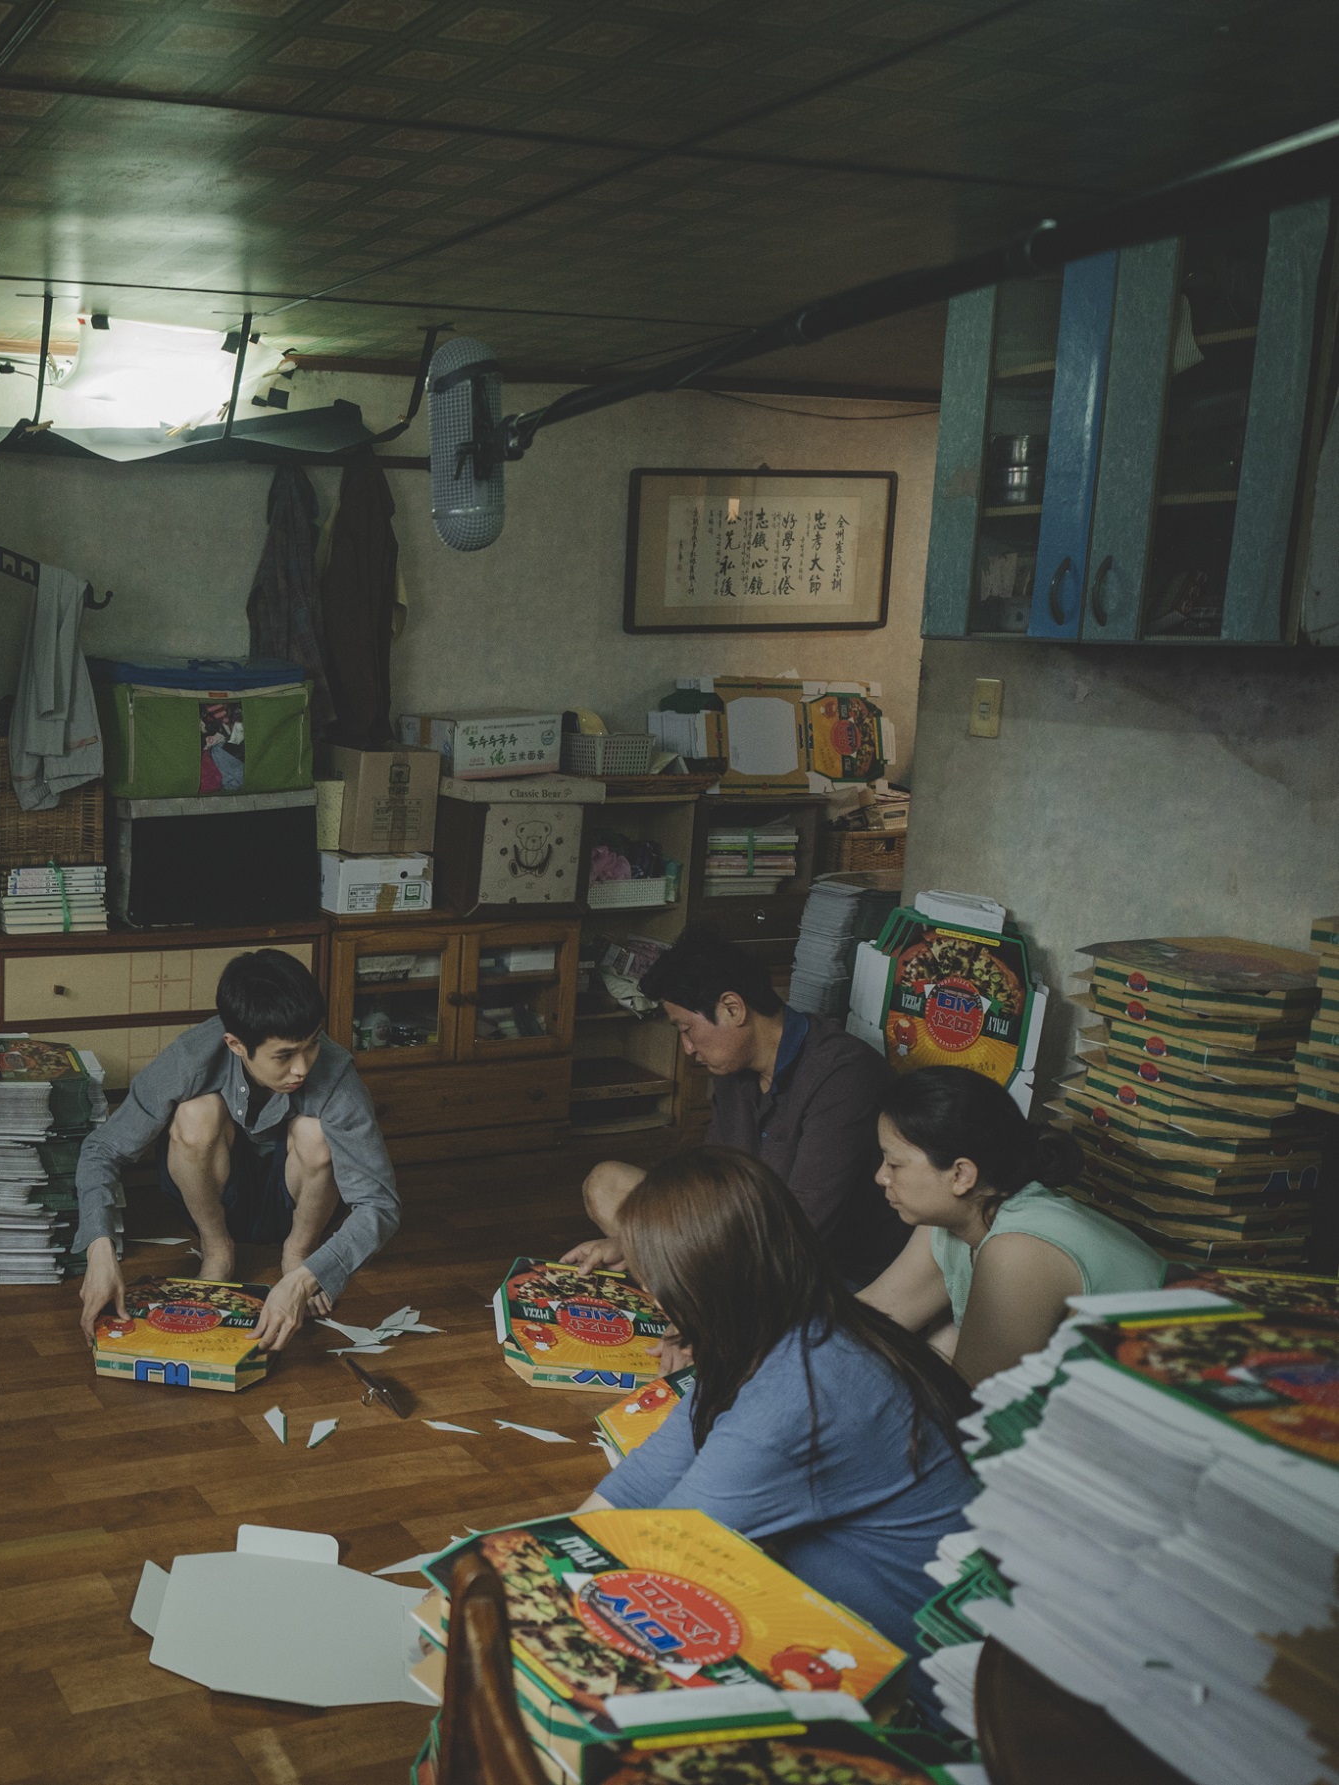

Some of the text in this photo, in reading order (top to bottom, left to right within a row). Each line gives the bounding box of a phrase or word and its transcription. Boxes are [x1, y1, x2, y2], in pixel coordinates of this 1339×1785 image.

[467, 733, 519, 749] 옥수수국수
[509, 788, 562, 798] Classic Bear
[901, 992, 922, 1012] PIZZA
[937, 991, 976, 1014] 시대
[932, 1010, 975, 1035] 피자
[986, 1015, 1010, 1036] ITALY
[226, 1316, 255, 1327] ITALY
[523, 1306, 550, 1320] PIZZA
[568, 1306, 618, 1322] 시대
[569, 1319, 624, 1335] 피자
[555, 1535, 610, 1569] ITALY
[595, 1590, 687, 1654] 시대
[628, 1579, 721, 1645] 피자
